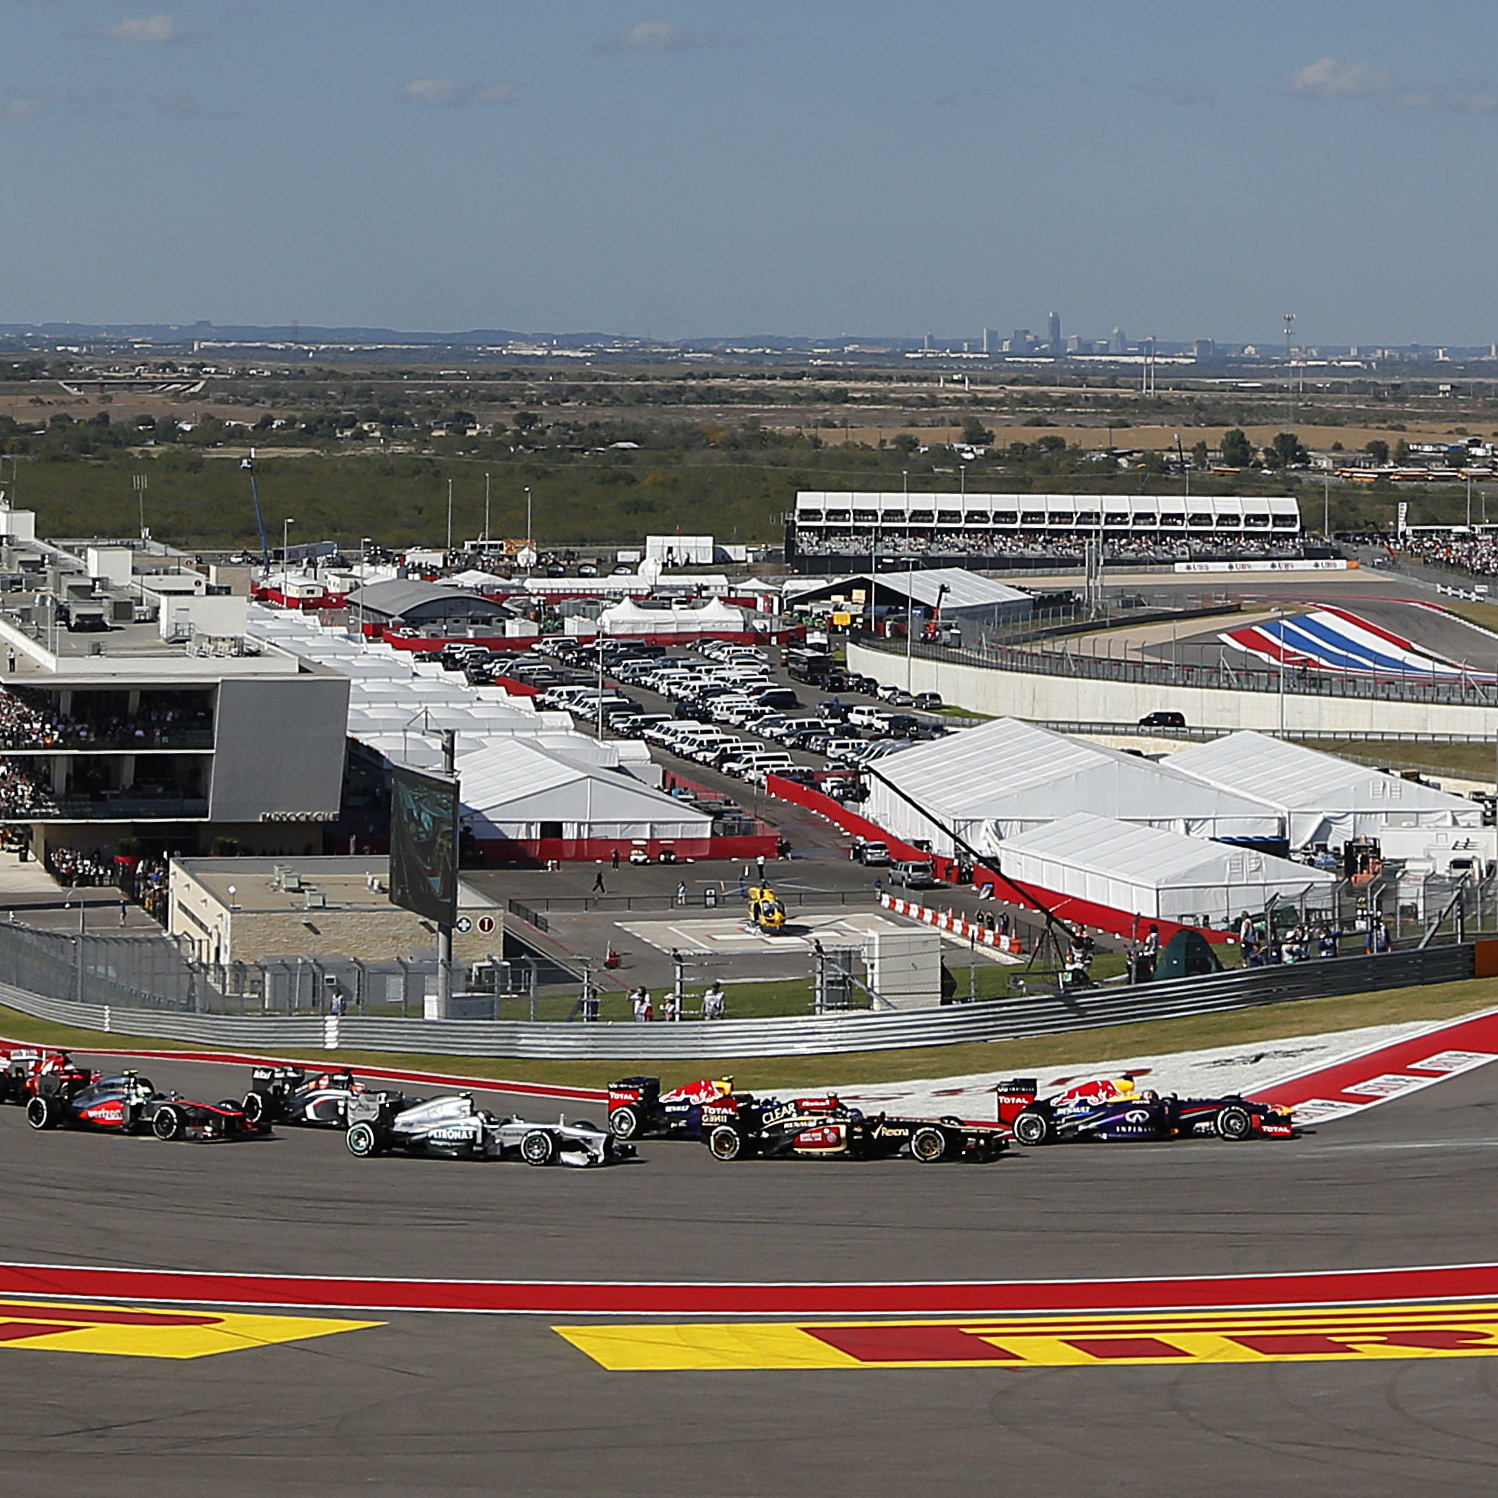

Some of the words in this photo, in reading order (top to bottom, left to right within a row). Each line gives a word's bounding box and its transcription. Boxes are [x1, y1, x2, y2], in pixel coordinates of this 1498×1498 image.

[609, 1091, 635, 1101] TOTAL
[998, 1095, 1029, 1104] TOTAL
[87, 1108, 123, 1121] verizon
[701, 1105, 736, 1115] TOTAL
[760, 1102, 795, 1124] CLEAR
[428, 1128, 474, 1140] PETRONAS
[1262, 1125, 1290, 1133] TOTAL
